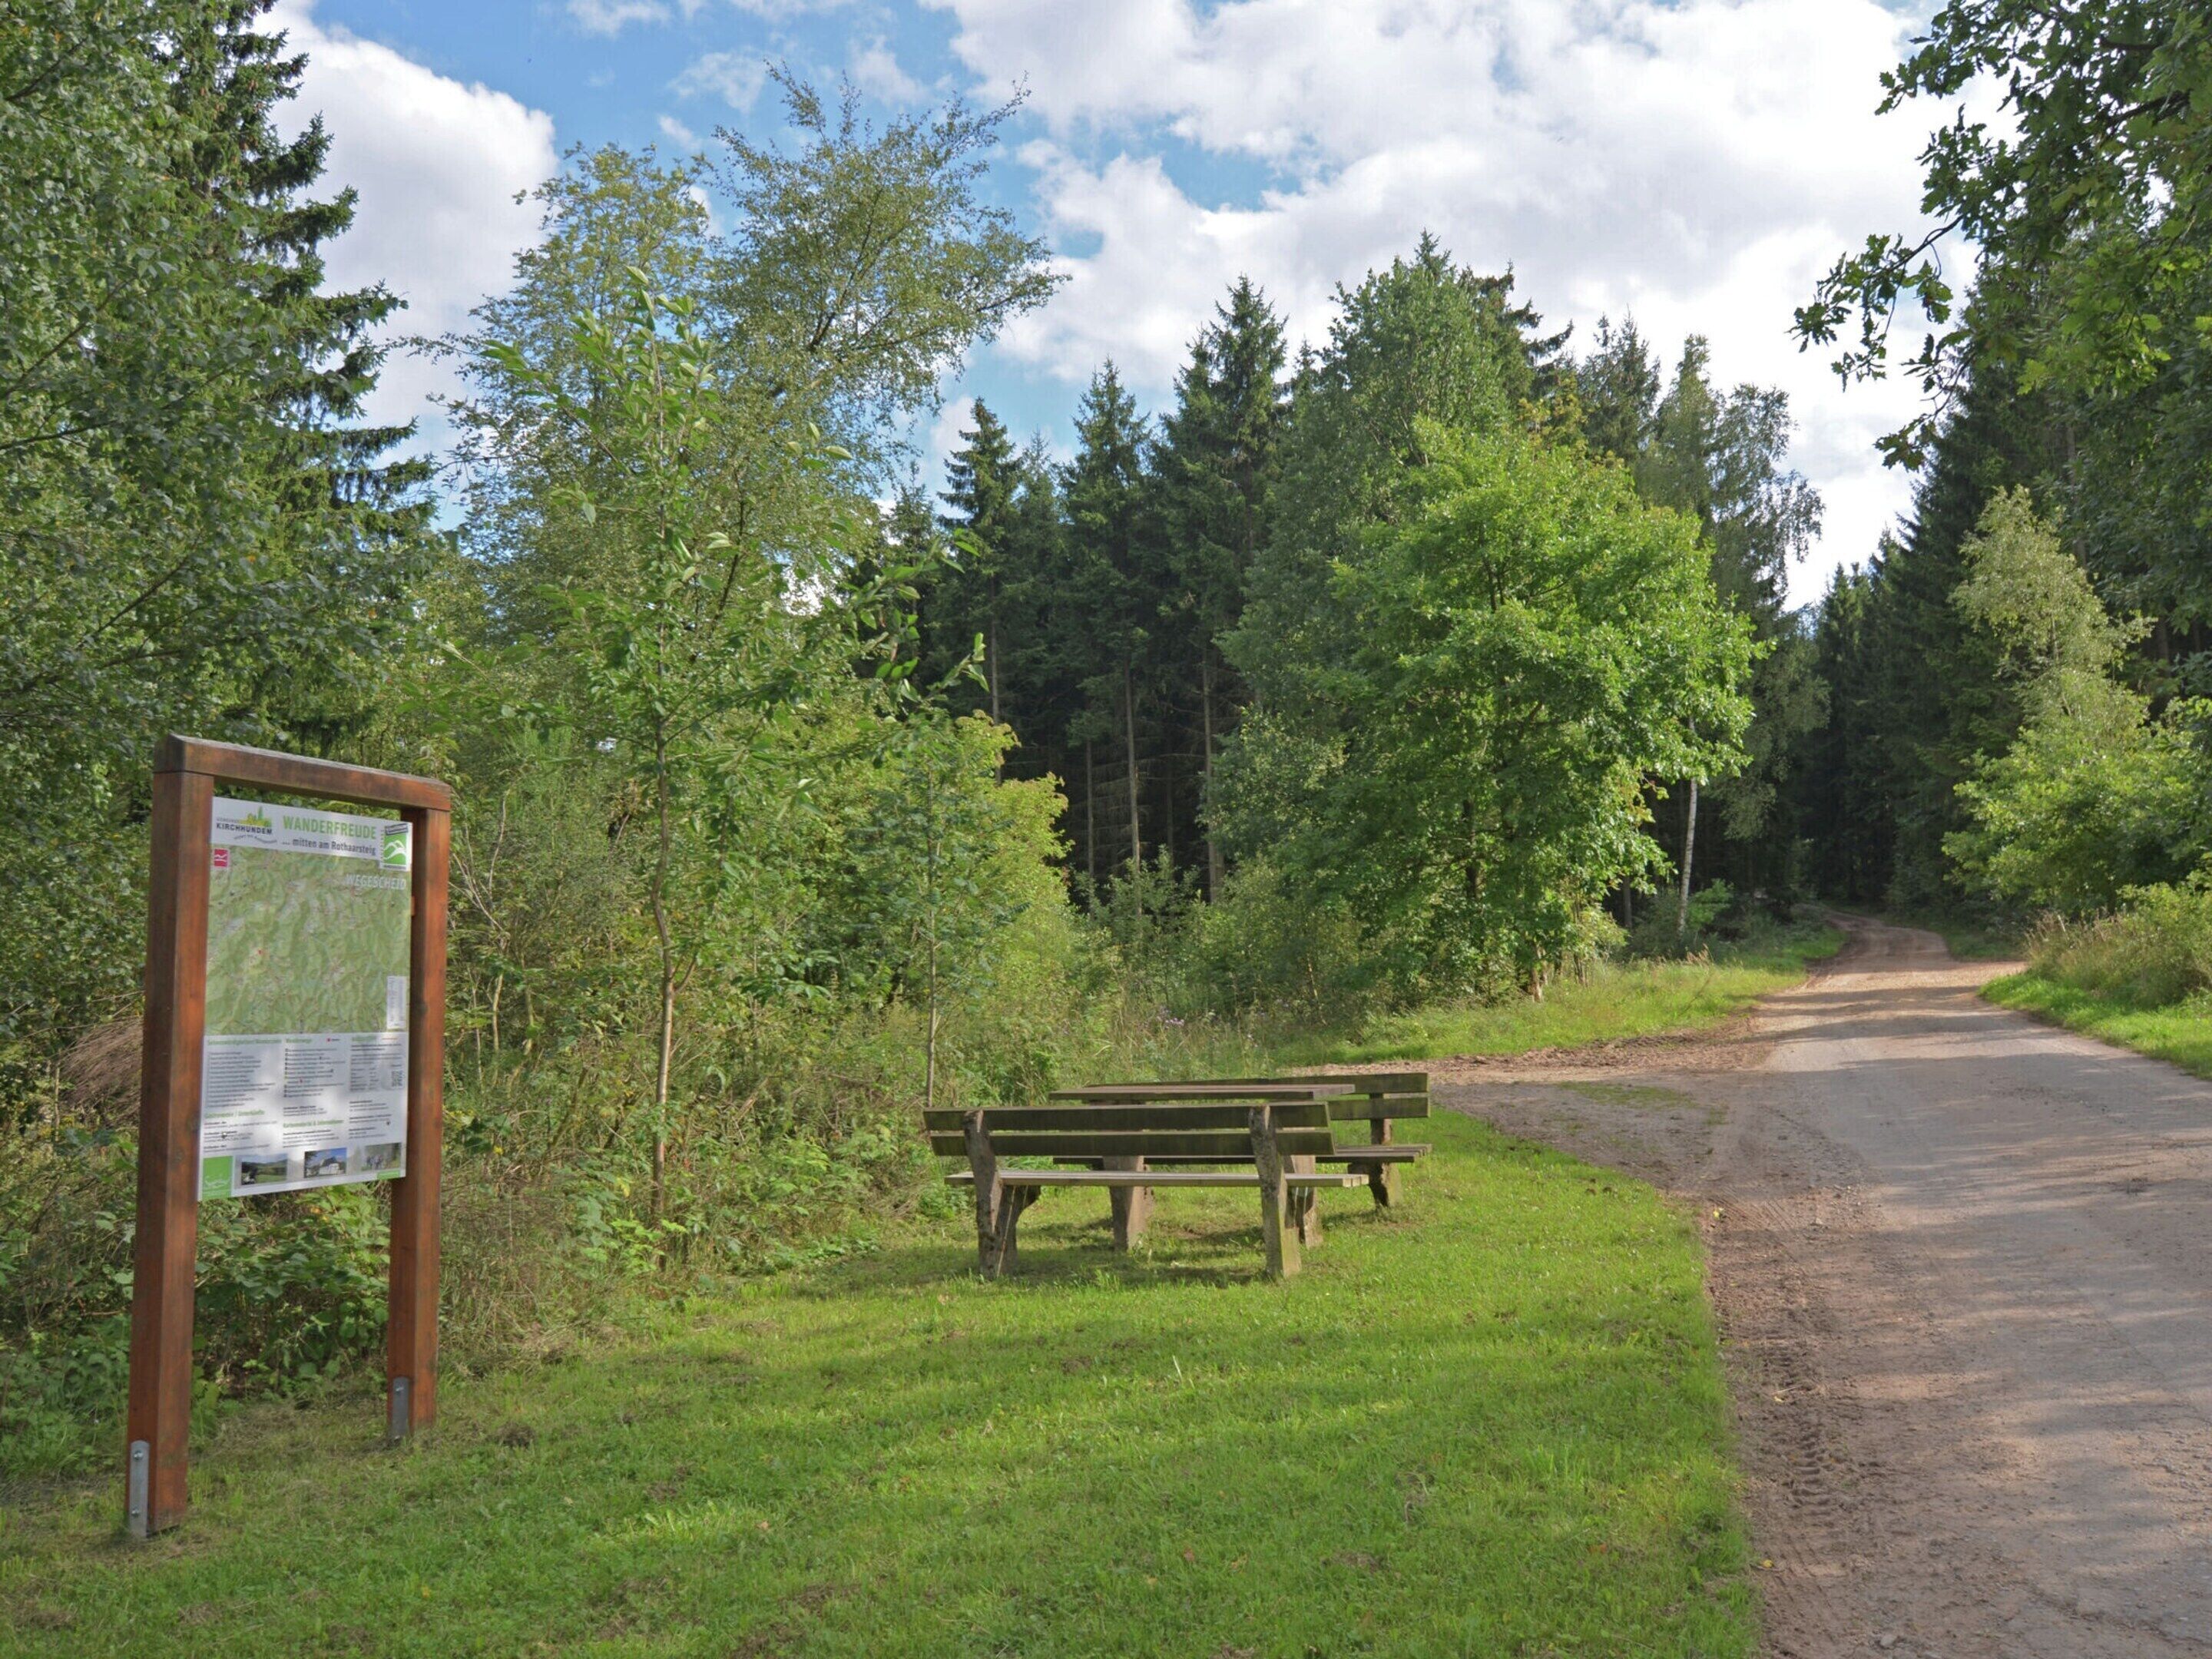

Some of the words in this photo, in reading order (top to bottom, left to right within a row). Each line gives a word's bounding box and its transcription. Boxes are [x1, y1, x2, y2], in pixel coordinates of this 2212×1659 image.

[217, 823, 273, 835] KIRCHHUNDEM
[283, 815, 376, 839] WANDERFREUDE
[293, 838, 316, 849] mitten
[332, 841, 376, 856] Rothaarsteig
[346, 873, 406, 891] WEGESCHEID
